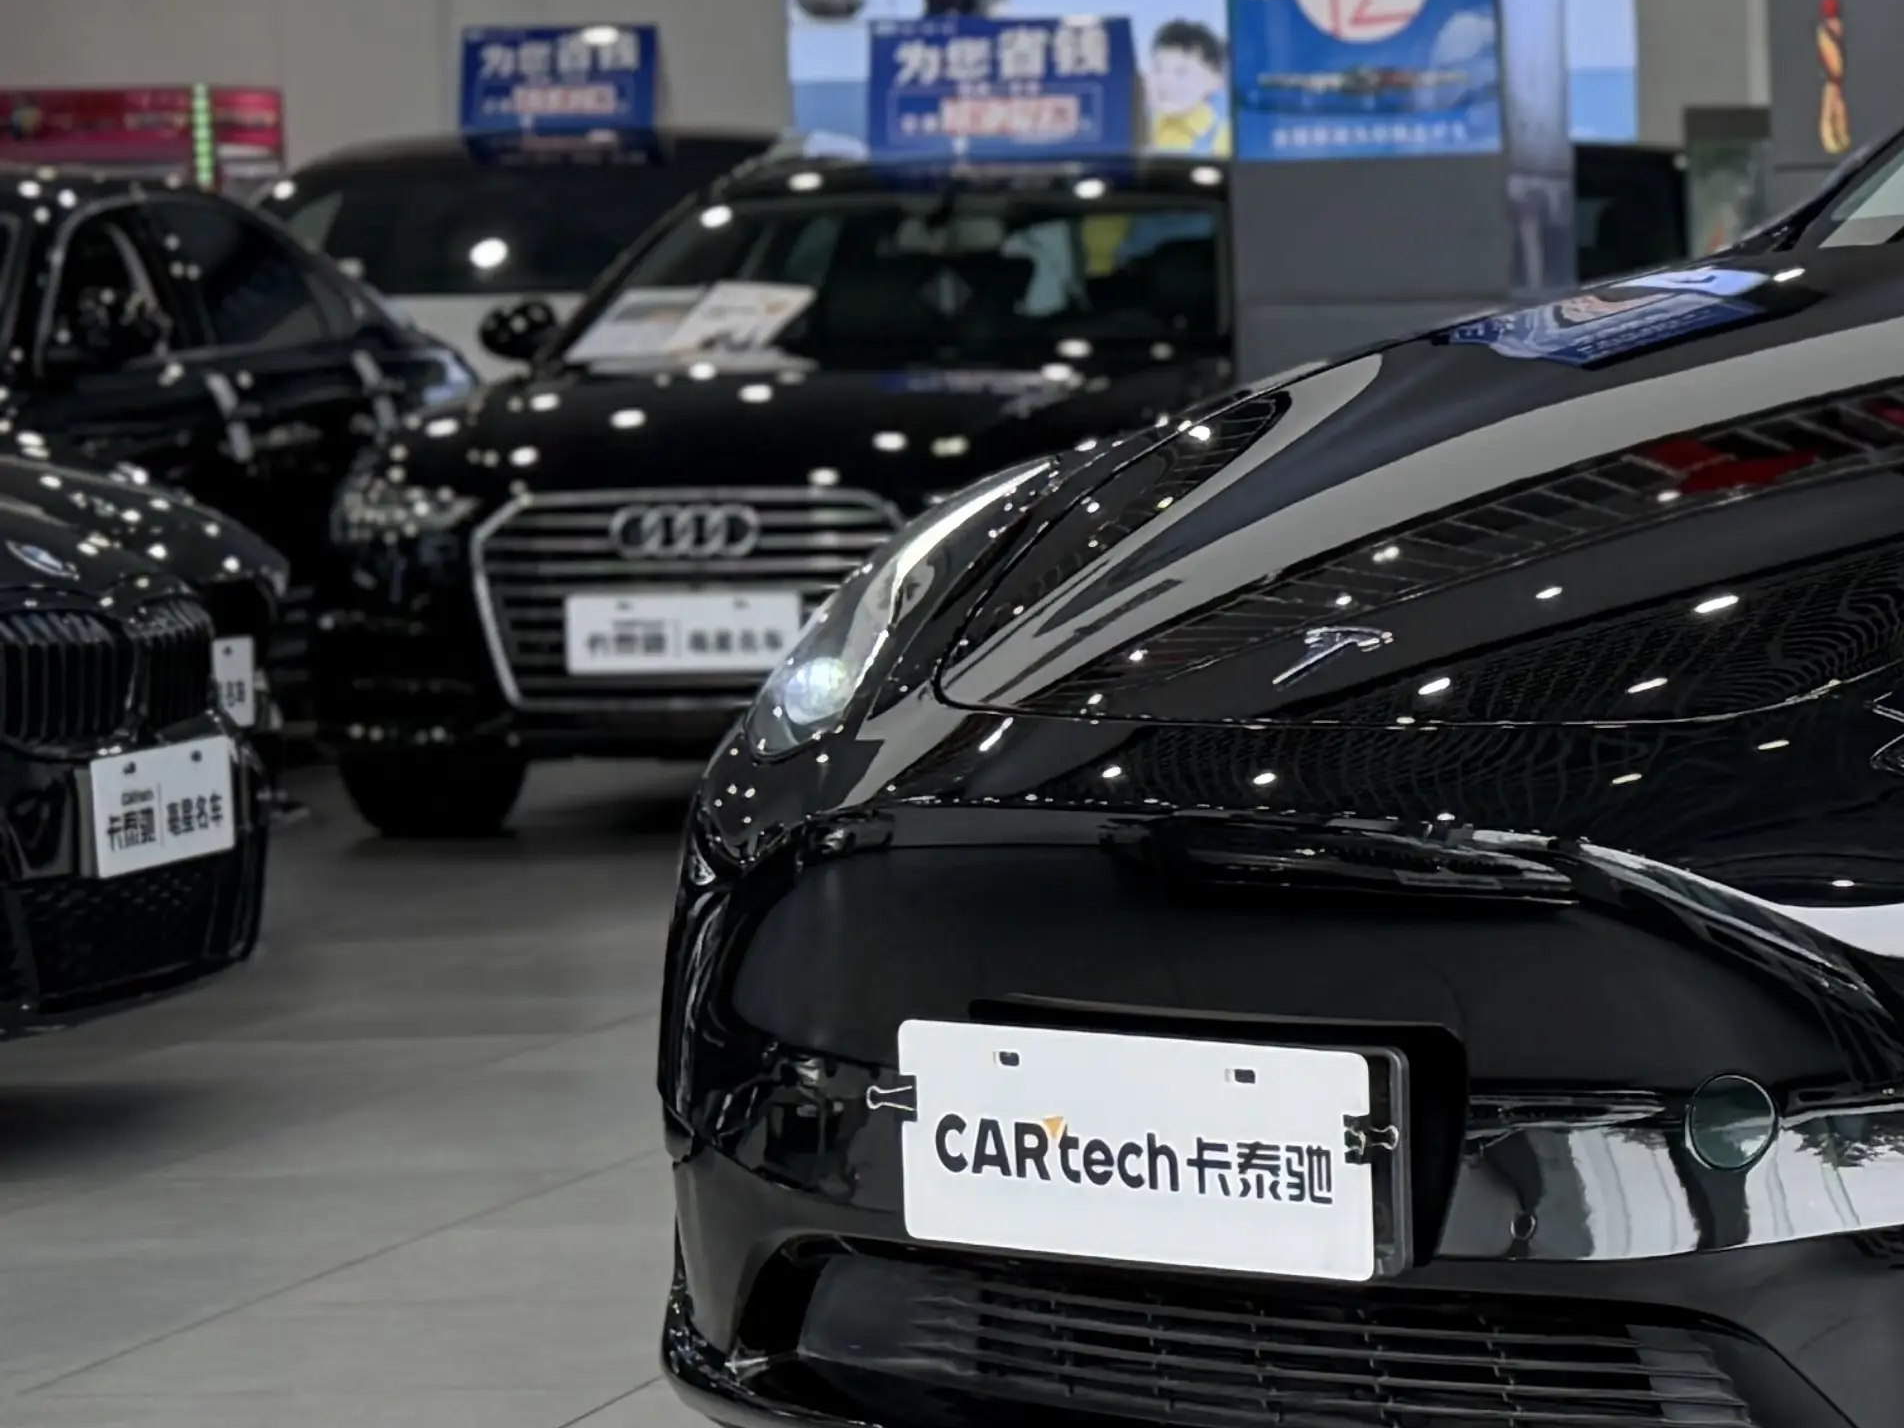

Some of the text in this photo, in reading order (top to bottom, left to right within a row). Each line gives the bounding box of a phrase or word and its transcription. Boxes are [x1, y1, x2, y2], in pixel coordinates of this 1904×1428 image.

[934, 1113, 1333, 1205] CARtech 卡泰驰
